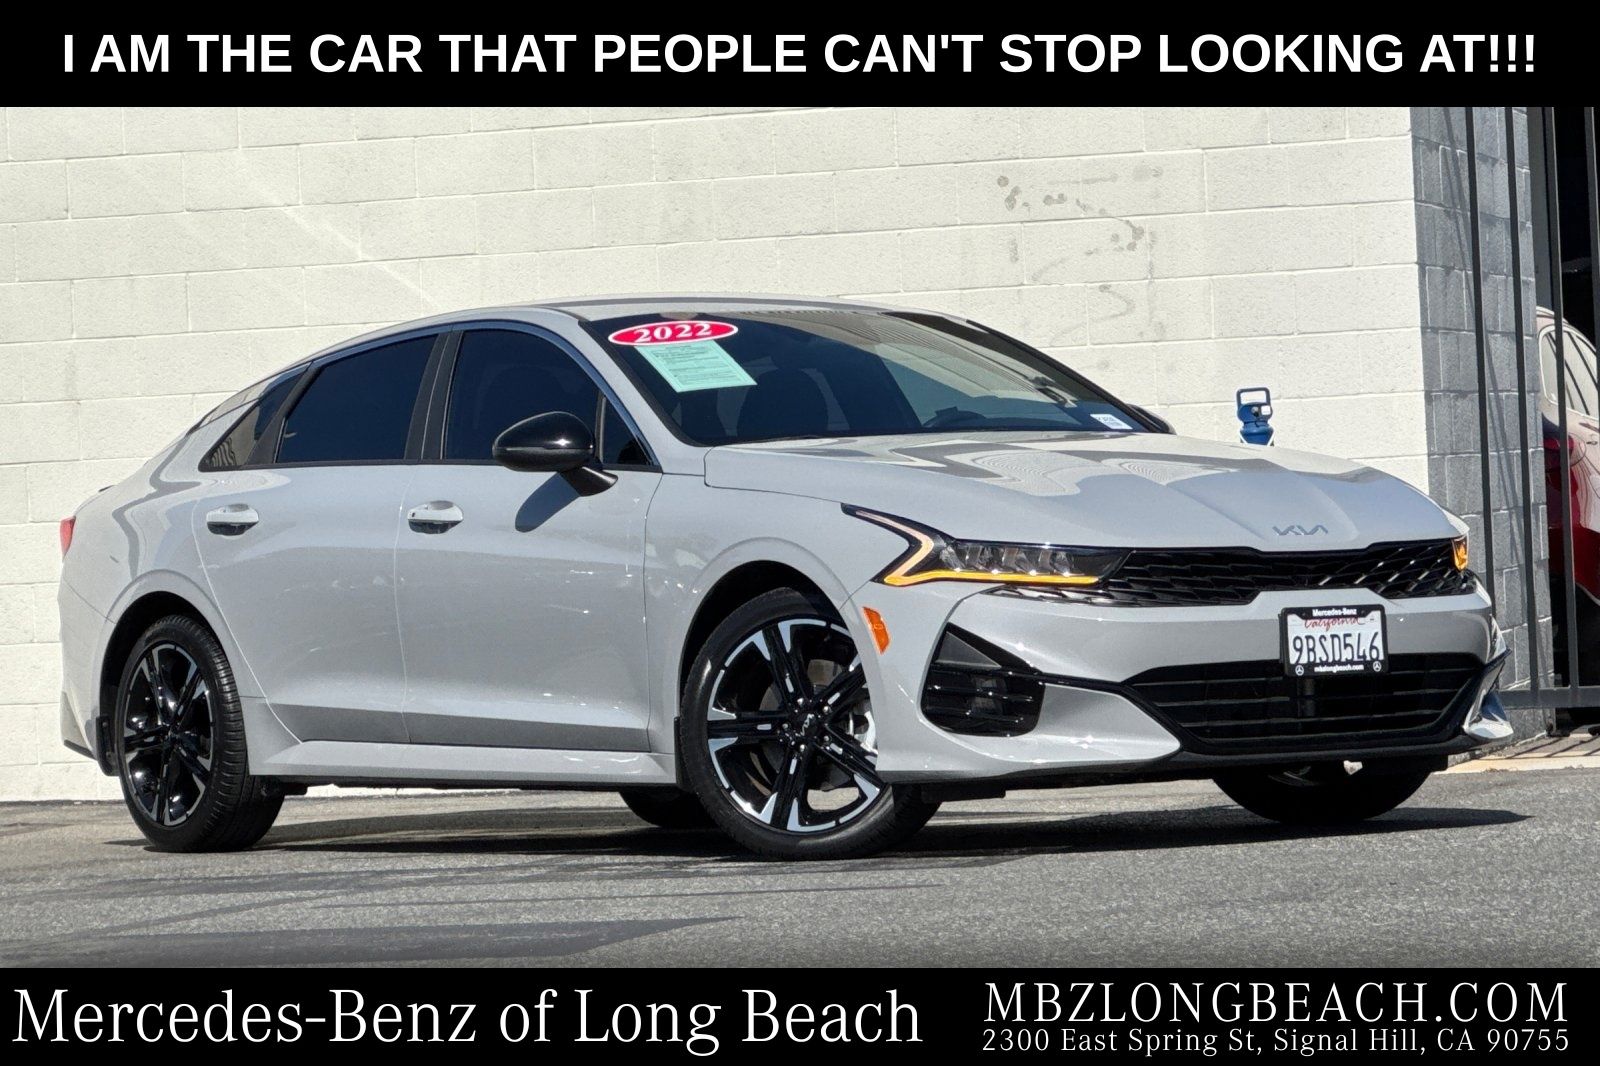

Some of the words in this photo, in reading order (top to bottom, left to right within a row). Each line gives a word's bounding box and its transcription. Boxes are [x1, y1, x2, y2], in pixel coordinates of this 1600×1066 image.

[633, 322, 713, 344] 2022
[1311, 607, 1357, 617] Mercedes-Benz
[1304, 616, 1366, 632] California
[1292, 631, 1380, 666] 9BSD546
